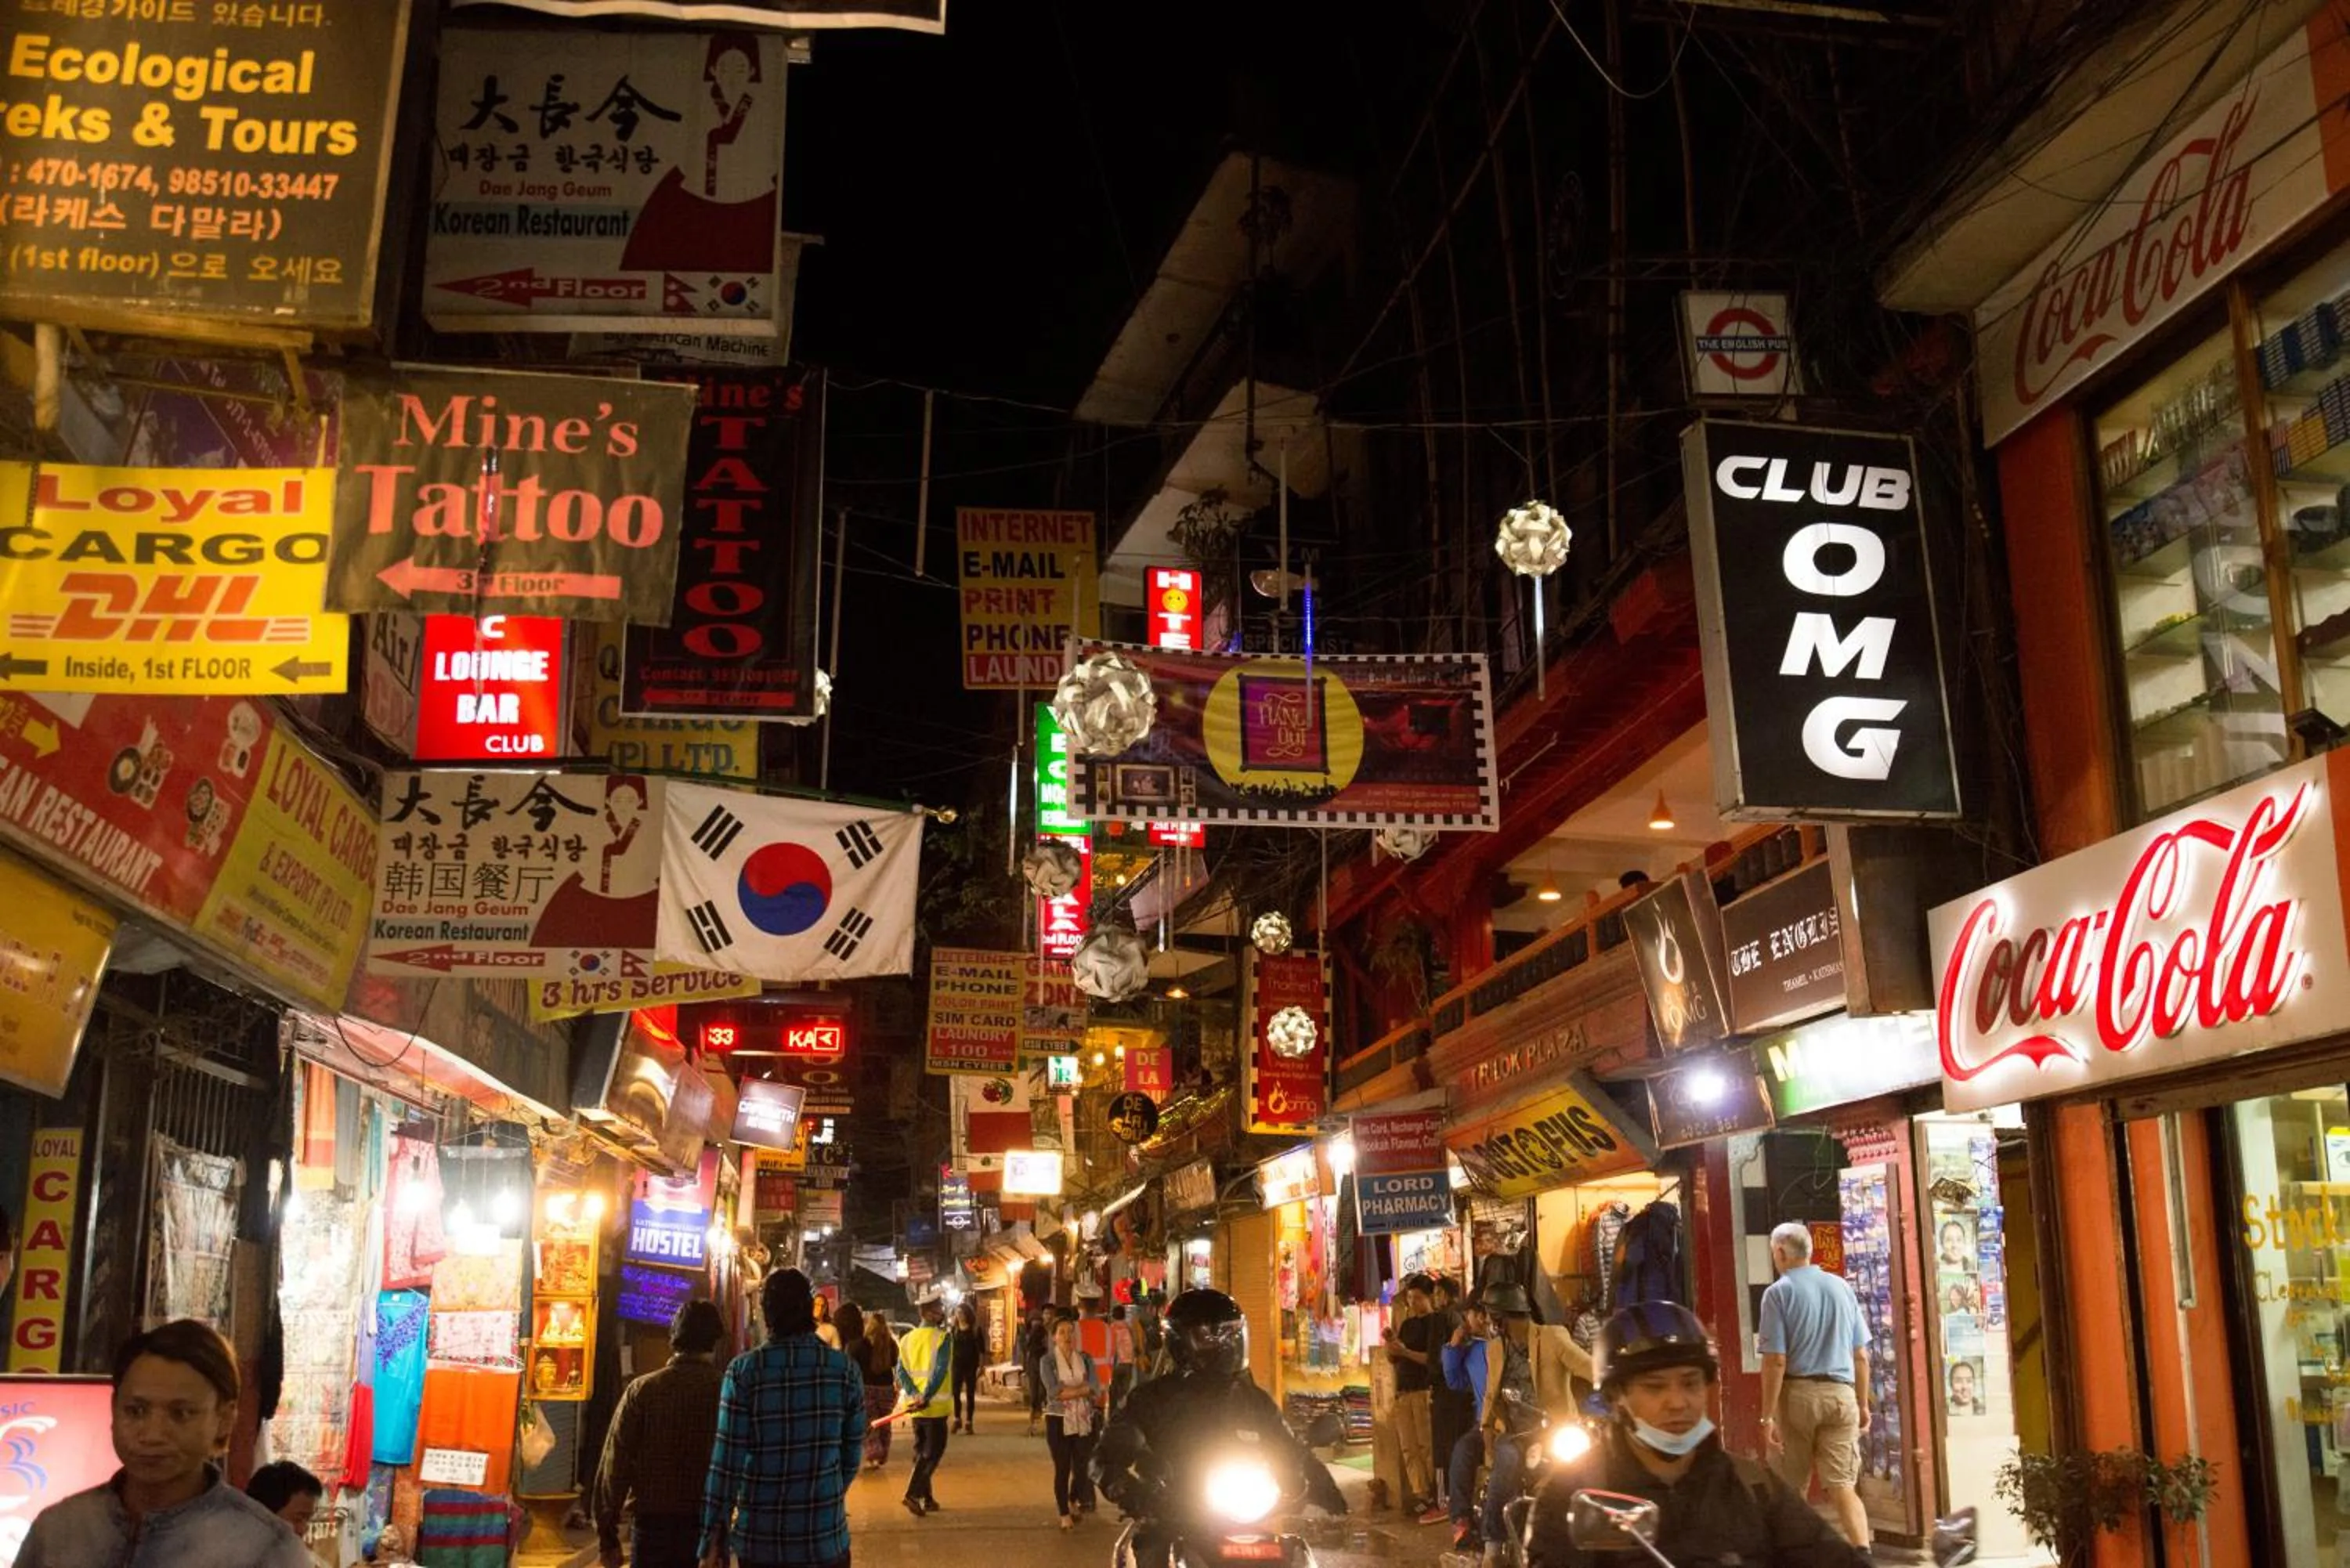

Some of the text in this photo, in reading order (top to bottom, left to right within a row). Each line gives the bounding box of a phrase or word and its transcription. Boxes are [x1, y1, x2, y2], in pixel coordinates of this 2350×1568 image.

[9, 34, 315, 101] Ecological
[0, 95, 358, 155] eks & Tours
[555, 145, 660, 174] 한국식당
[27, 160, 160, 196] 470-1674,
[168, 168, 339, 201] 98510-33447
[479, 180, 613, 199] Dae Jang Geum
[150, 206, 283, 240] 다말라)
[435, 204, 630, 237] Korean Restaurant
[9, 244, 343, 285] (1st floor) 으로 오세요
[475, 276, 647, 298] 2nd Floor
[707, 335, 768, 357] Machine
[1722, 338, 1766, 349] ENGLISH
[394, 395, 638, 457] Mine's
[1716, 455, 1912, 511] CLUB
[38, 474, 304, 523] Loyal
[356, 465, 663, 547] Tattoo
[682, 416, 770, 657] TATTOO
[961, 513, 1093, 544] INTERNET
[0, 526, 329, 565] CARGO
[964, 551, 1066, 580] E-MAIL
[499, 574, 566, 593] Floor
[50, 573, 270, 643] DHL
[965, 589, 1055, 615] PRINT
[967, 624, 1071, 652] PHONE
[1779, 522, 1908, 780] OMG
[65, 656, 251, 683] Inside, 1st FLOOR
[435, 650, 550, 681] LOUNGE
[970, 656, 1065, 684] LAUND
[456, 693, 520, 725] BAR
[485, 734, 544, 753] CLUB
[266, 744, 327, 841] LOYAL
[0, 754, 164, 893] AN RESTAURANT
[392, 832, 588, 862] 대장금 한국식당
[270, 850, 322, 906] EXPORT
[386, 862, 555, 905] 韩国餐厅
[381, 901, 530, 917] Dae Jang Geum
[374, 919, 530, 941] Korean Restaurant
[1058, 934, 1085, 945] FLOO
[407, 951, 546, 966] 2nd Floor
[935, 966, 1018, 980] E-MAIL
[937, 951, 1017, 966] INTERNET
[1025, 958, 1073, 977] GAM
[542, 970, 743, 1009] 3 hrs Service
[935, 981, 1018, 995] PHONE
[978, 998, 1018, 1011] PRINT
[935, 1012, 1017, 1028] SIM CARD
[935, 1028, 1010, 1042] LAUNDRY
[948, 1044, 989, 1057] 100
[1137, 1051, 1160, 1066] DE
[1138, 1070, 1160, 1086] LA
[1123, 1097, 1143, 1111] DE
[34, 1138, 77, 1158] LOYAL
[1472, 1105, 1617, 1180] OCTOPUS
[1373, 1177, 1435, 1194] LORD
[1362, 1194, 1450, 1216] PHARMACY
[2243, 1183, 2345, 1251] Stock
[631, 1227, 703, 1259] HOSTEL
[16, 1170, 70, 1374] CARG
